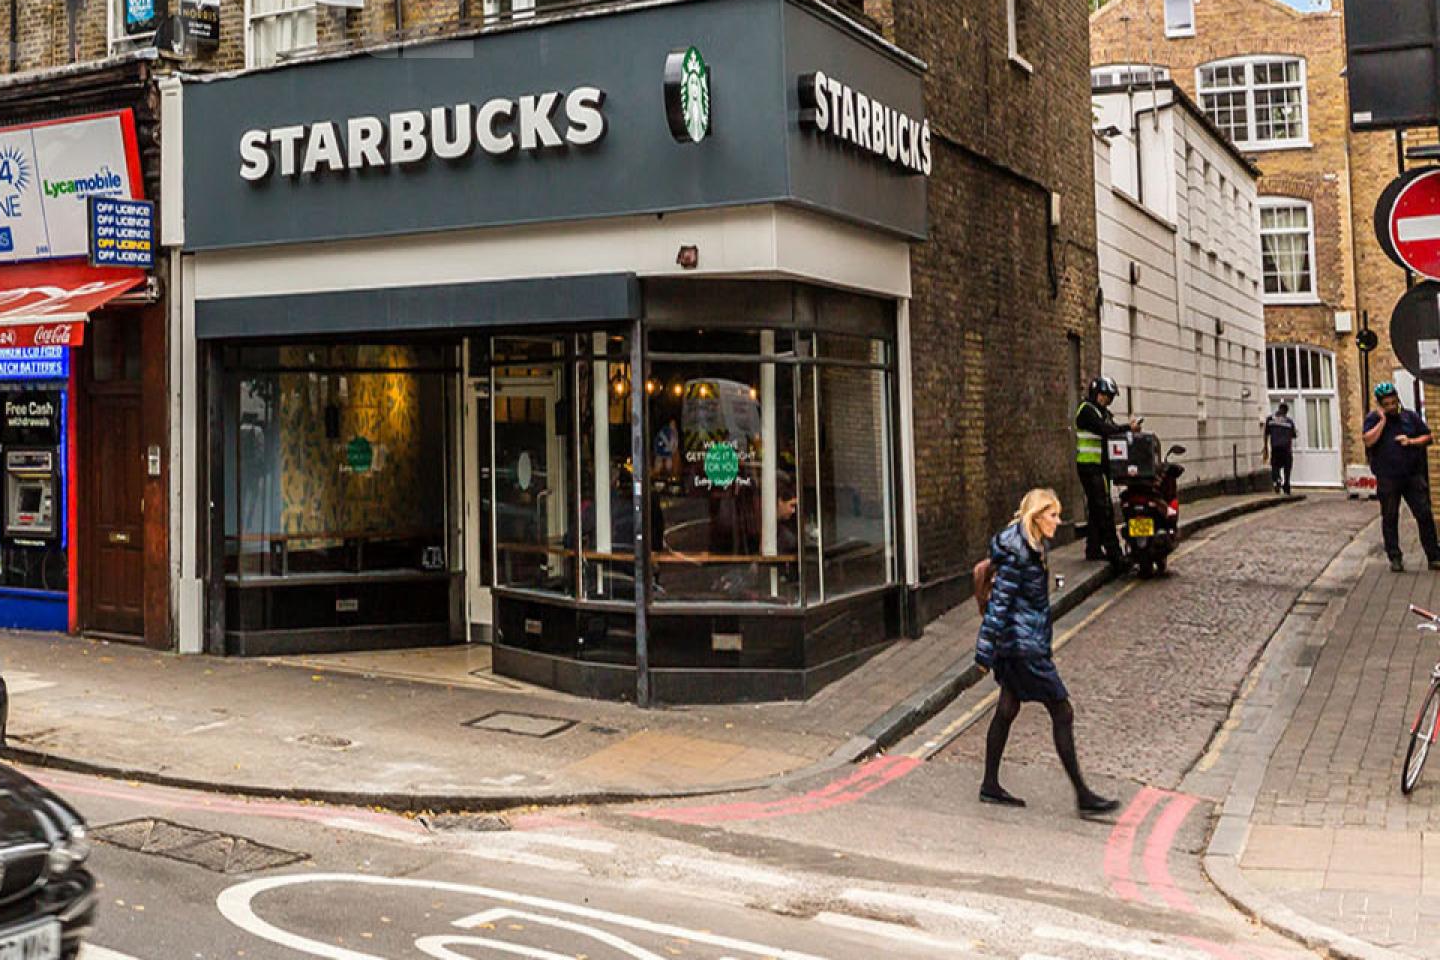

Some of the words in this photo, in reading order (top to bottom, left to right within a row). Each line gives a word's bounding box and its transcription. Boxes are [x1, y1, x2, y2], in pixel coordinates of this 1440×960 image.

[813, 70, 933, 177] STARBUCKS
[239, 85, 607, 183] STARBUCKS
[43, 171, 120, 198] Lycamobile
[97, 202, 114, 213] OFF
[115, 204, 150, 216] LICENCE
[97, 214, 114, 225] OFF
[115, 216, 150, 227] LICENCE
[97, 226, 114, 237] OFF
[115, 228, 150, 239] LICENCE
[98, 238, 114, 248] OFF
[116, 240, 150, 251] LICENCE
[98, 250, 114, 260] OFF
[116, 251, 150, 262] LICENCE
[34, 324, 72, 345] Coca-Cola
[20, 361, 62, 375] BATTERIES
[6, 401, 27, 415] Free
[30, 401, 53, 415] Cash
[8, 417, 50, 427] withdrawals
[1113, 444, 1122, 456] L
